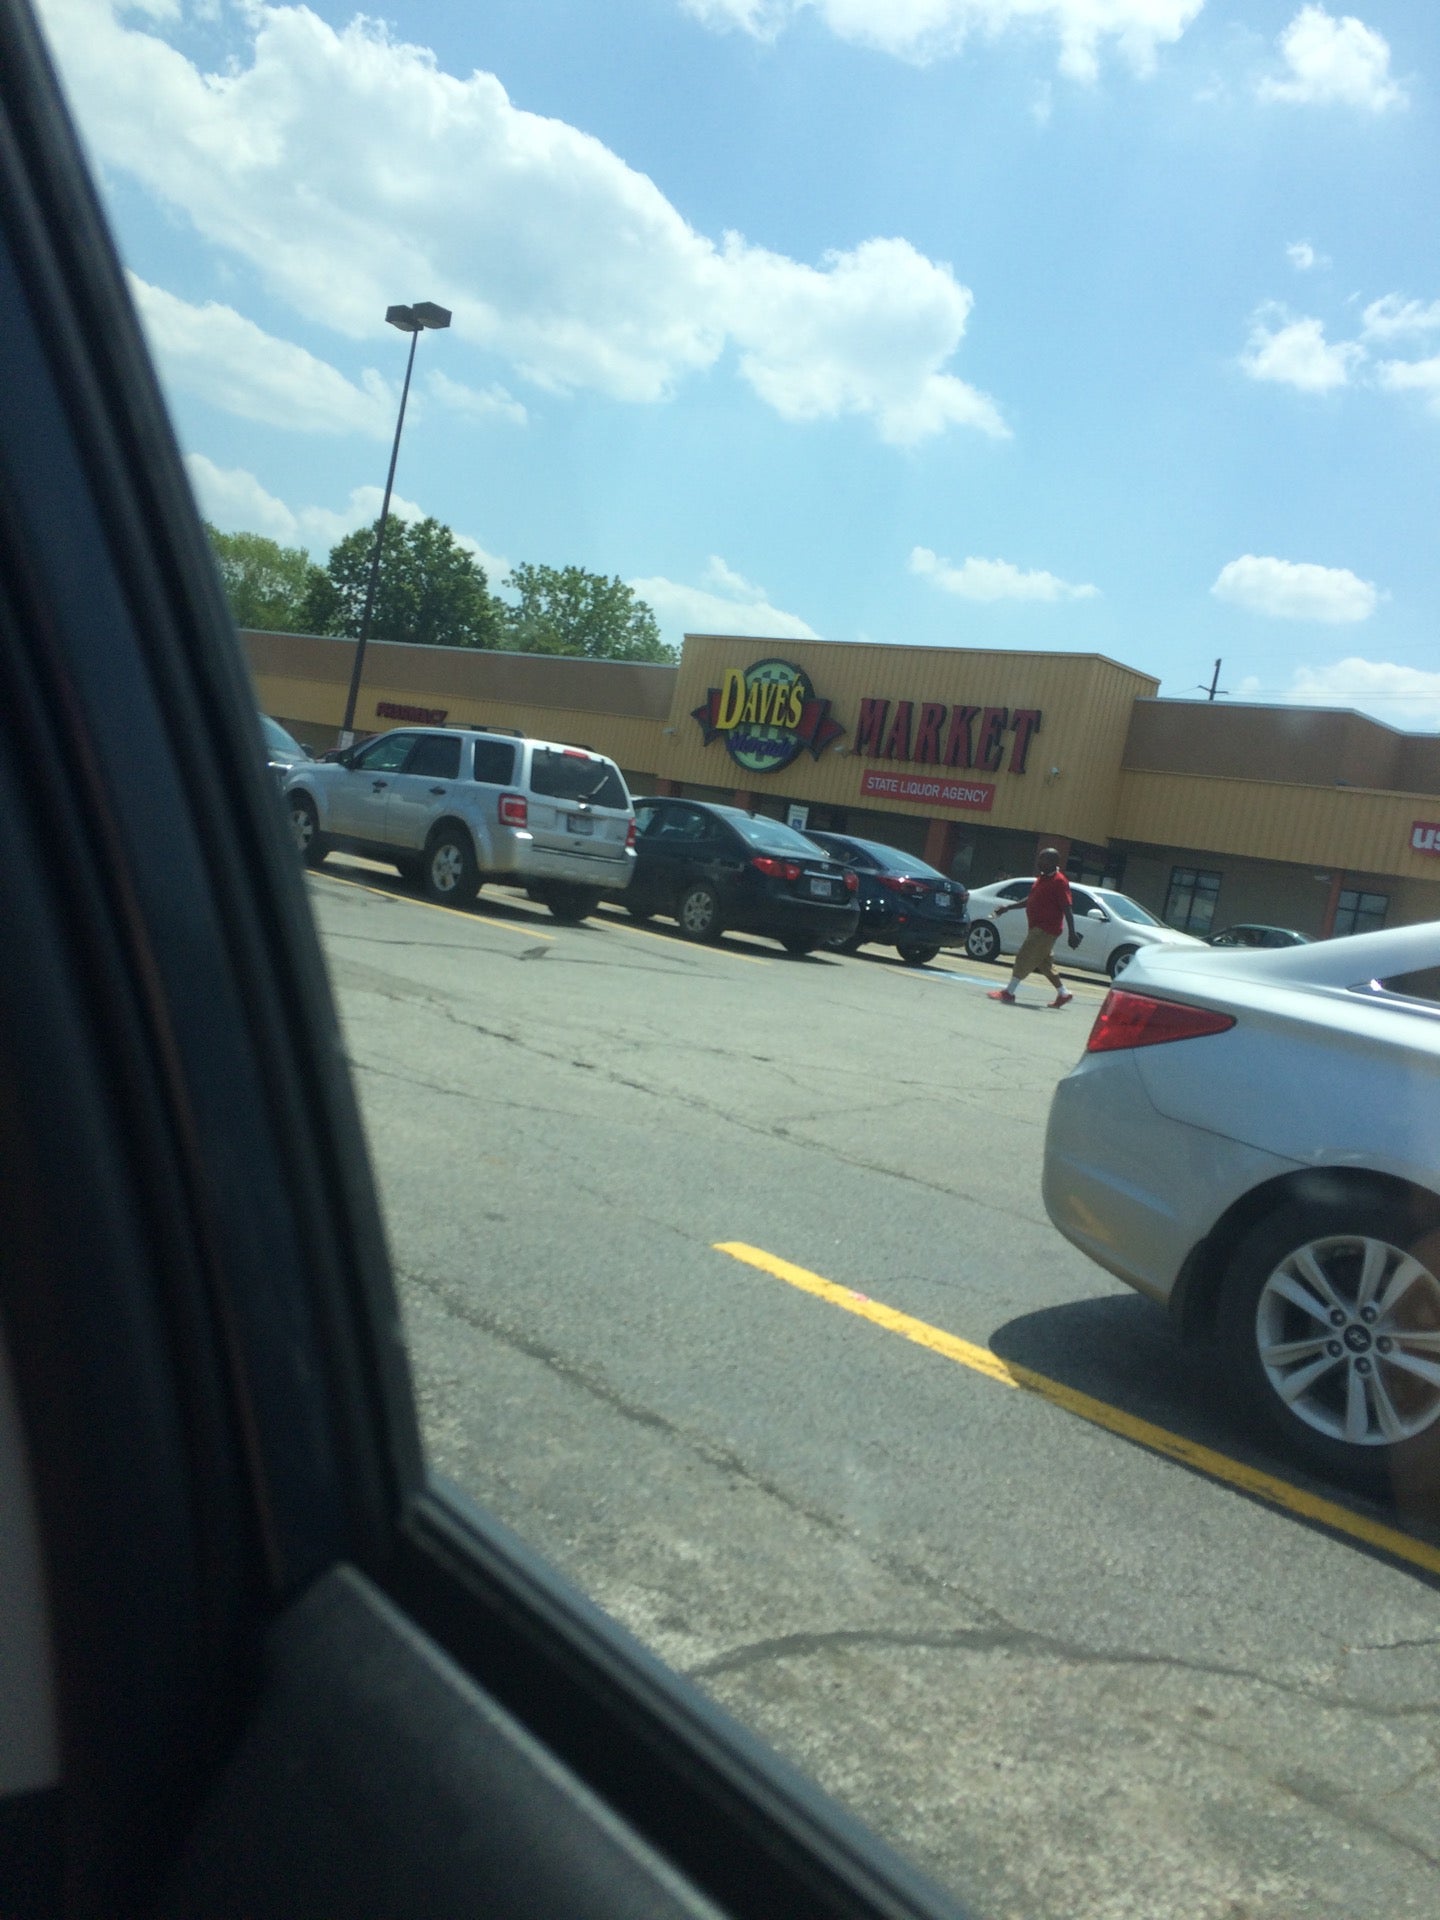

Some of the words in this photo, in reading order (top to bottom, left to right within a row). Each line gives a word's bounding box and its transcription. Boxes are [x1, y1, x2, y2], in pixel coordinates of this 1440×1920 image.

[716, 668, 805, 729] DAVE'S
[853, 697, 1042, 774] MARKET
[867, 776, 899, 793] STATE
[900, 780, 940, 798] LIQUOR
[942, 785, 989, 804] AGENCY
